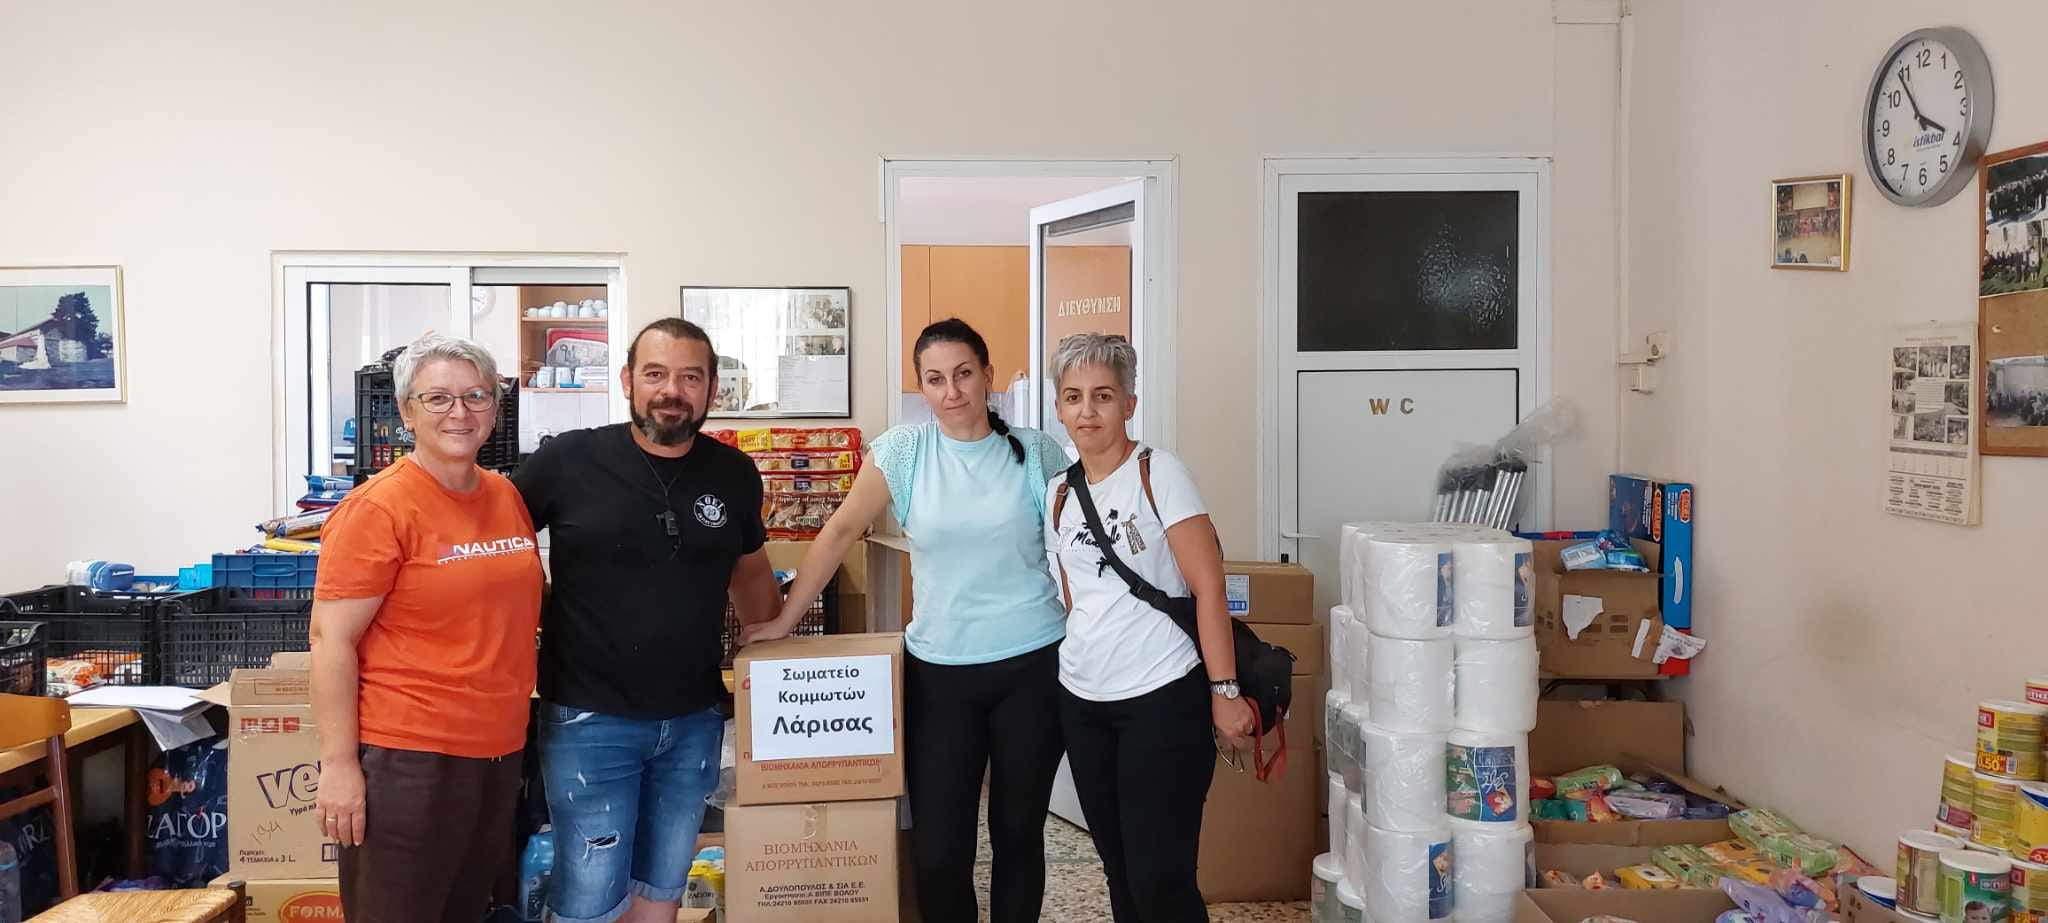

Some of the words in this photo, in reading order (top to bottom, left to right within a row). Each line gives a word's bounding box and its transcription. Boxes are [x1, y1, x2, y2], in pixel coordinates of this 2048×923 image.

[1915, 48, 1931, 69] 12
[1940, 52, 1947, 70] 1
[1900, 64, 1911, 82] 11
[1953, 70, 1964, 90] 2
[1887, 90, 1901, 109] 10
[1959, 97, 1968, 116] 3
[1881, 119, 1890, 137] 9
[1952, 131, 1961, 147] 4
[1886, 148, 1895, 166] 8
[1938, 155, 1949, 174] 5
[1901, 163, 1910, 181] 7
[1918, 167, 1928, 186] 6
[1058, 296, 1121, 317] ΔΙΕΥΘΥΝΣΗ
[453, 536, 535, 555] NAUTICA
[782, 666, 860, 684] Σωματείο
[778, 687, 866, 706] Κομμωτών
[773, 715, 873, 738] Λάρισας
[764, 840, 857, 855] ΒΙΟΜΗΧΑΝΙΑ
[745, 855, 878, 872] ΑΠΟΡΡΥΠΑΝΤΙΚΩΝ
